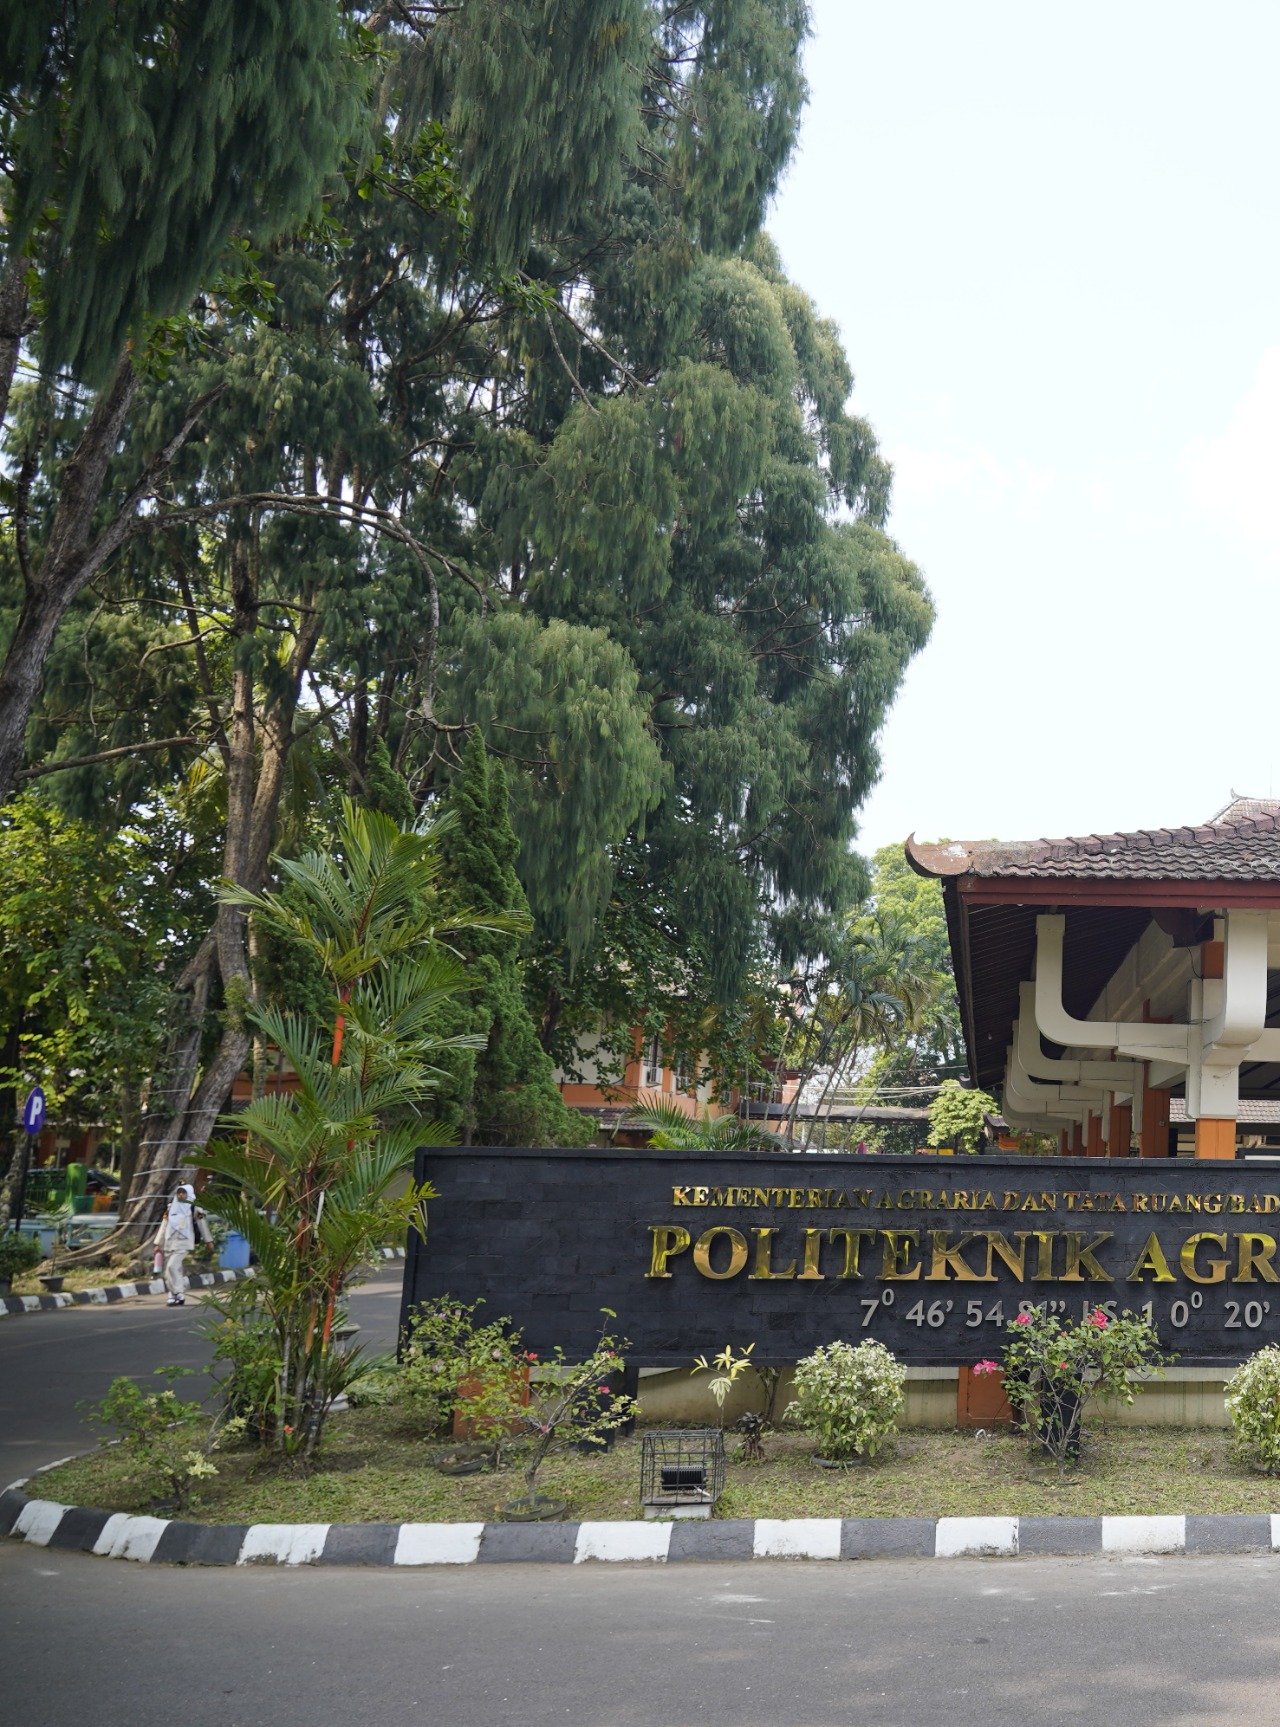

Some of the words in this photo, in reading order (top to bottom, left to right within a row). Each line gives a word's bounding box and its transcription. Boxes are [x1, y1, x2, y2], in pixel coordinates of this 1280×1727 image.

[29, 1096, 43, 1126] P
[671, 1186, 873, 1209] KEMENTERIAN
[875, 1189, 999, 1211] AGRARIA
[1001, 1191, 1058, 1212] DAN
[1063, 1192, 1127, 1213] TATA
[643, 1225, 1115, 1283] POLITEKNIK
